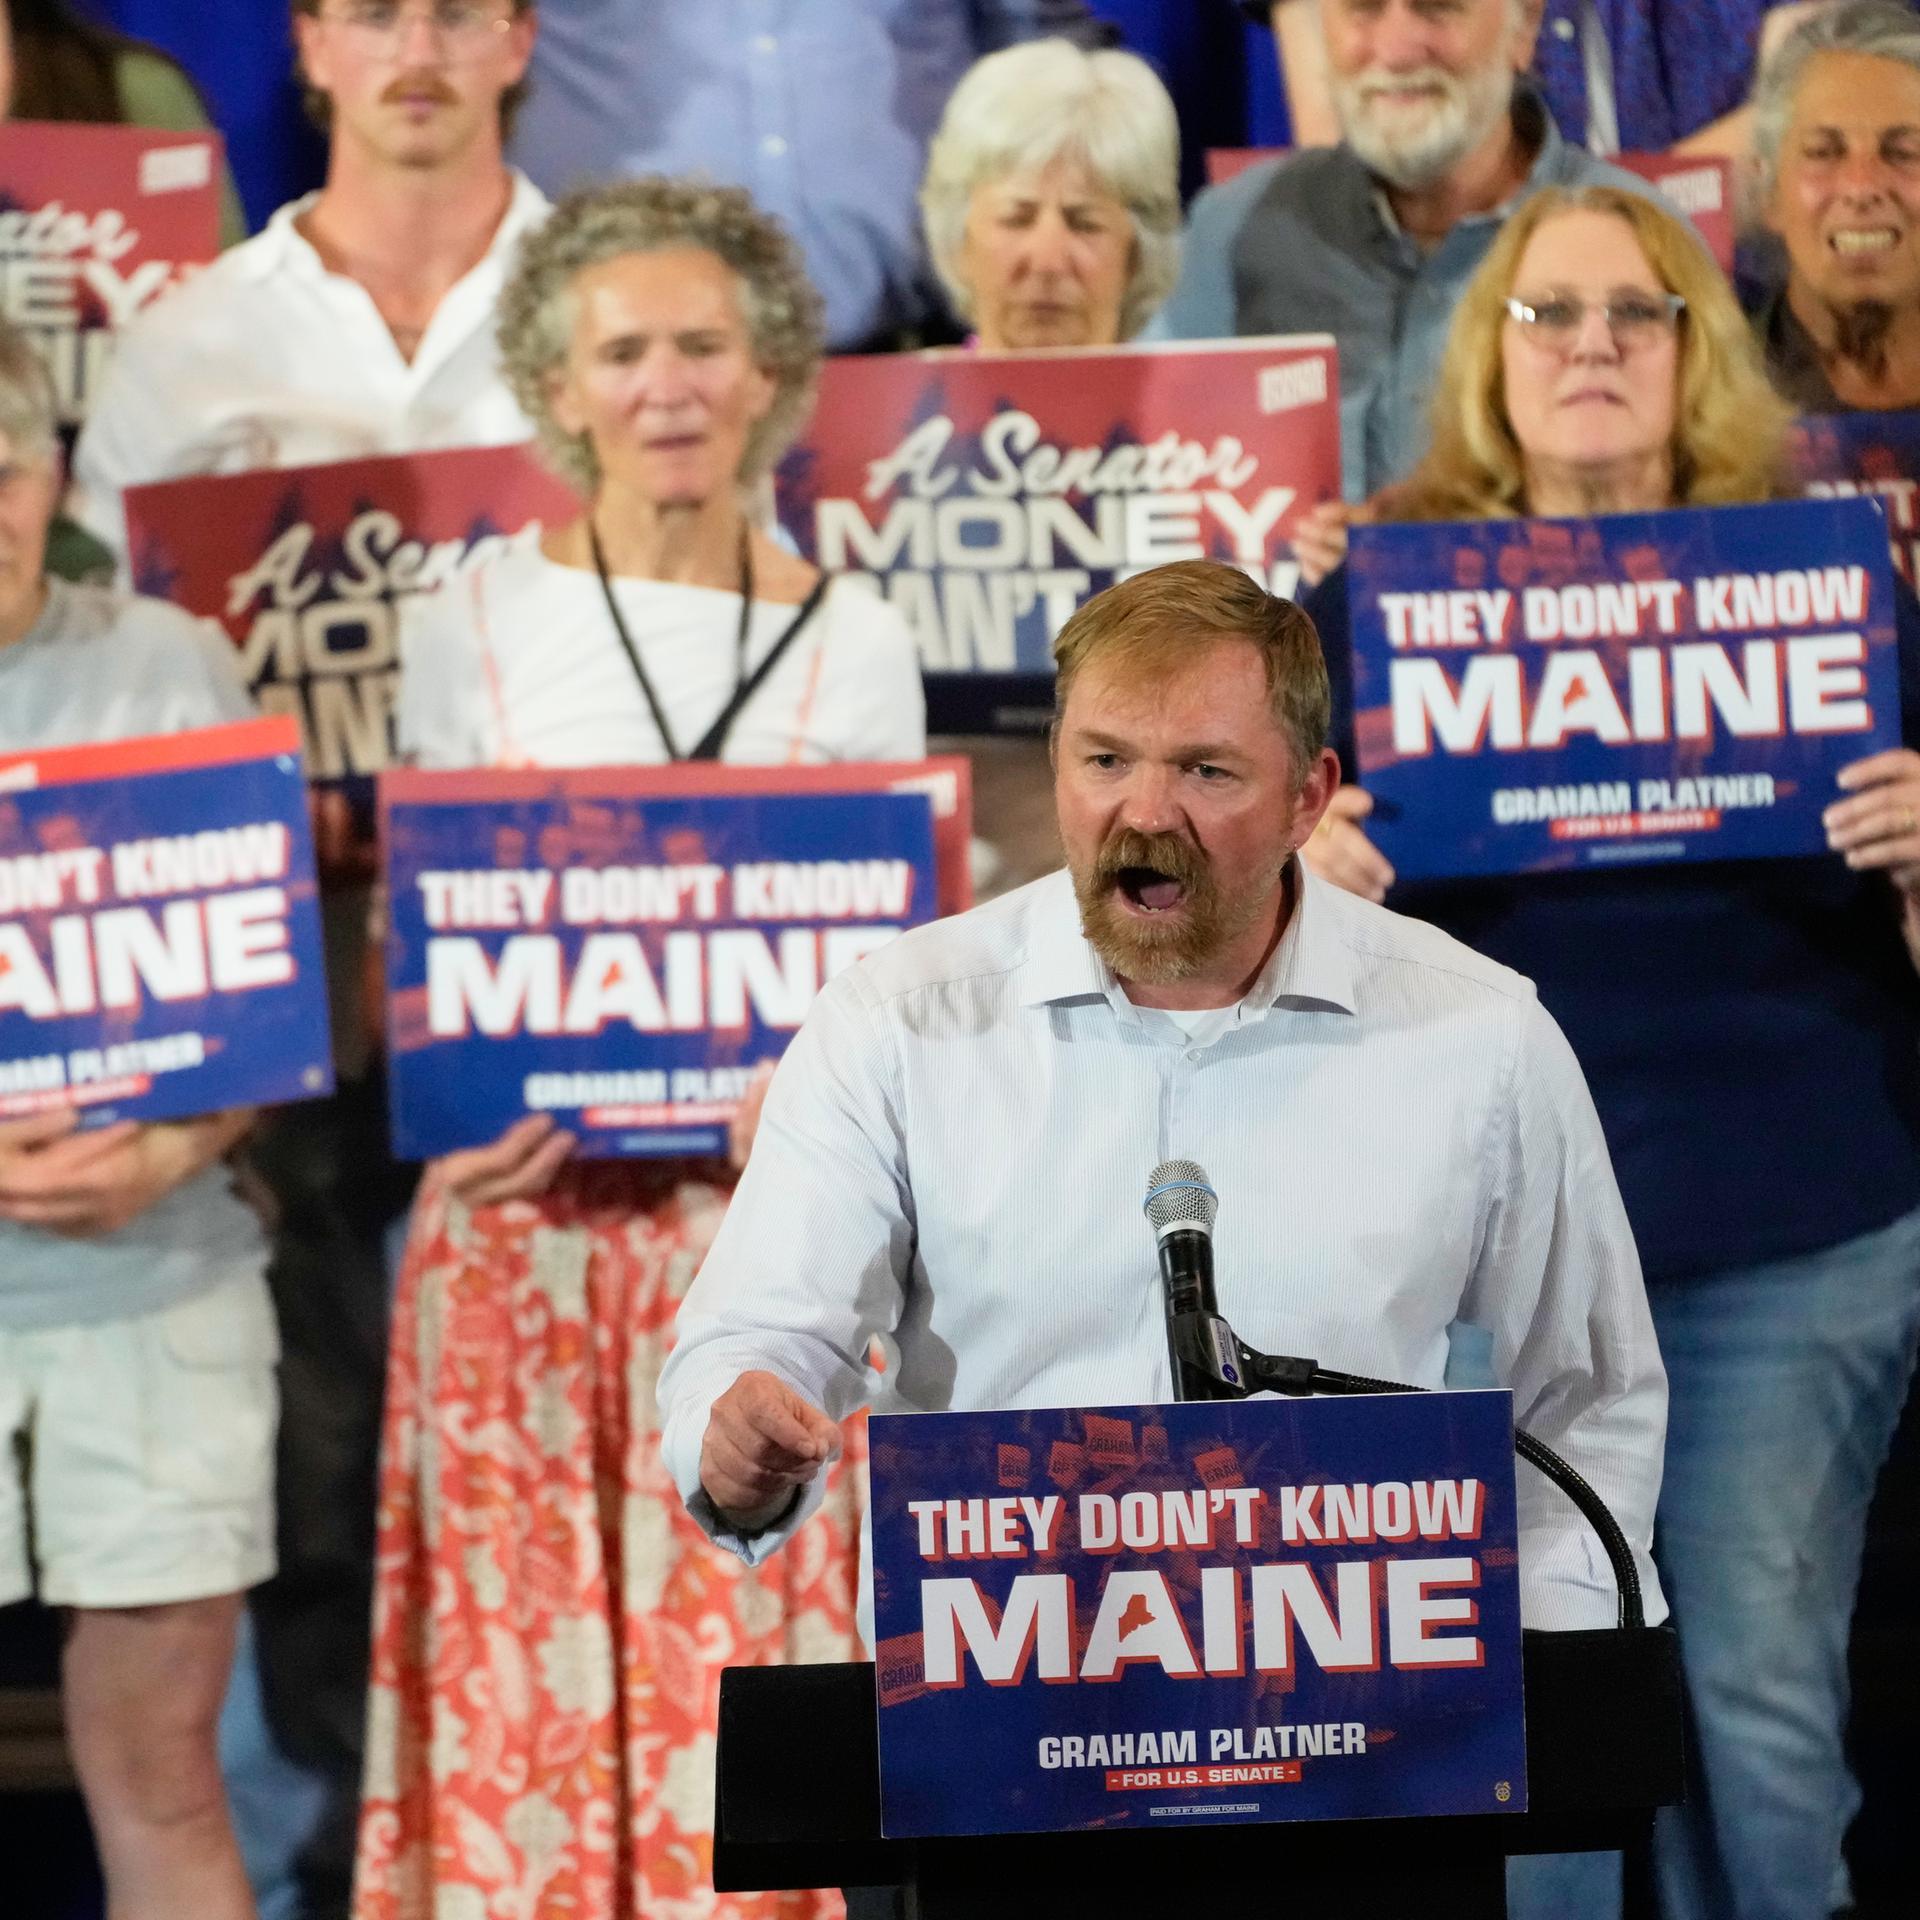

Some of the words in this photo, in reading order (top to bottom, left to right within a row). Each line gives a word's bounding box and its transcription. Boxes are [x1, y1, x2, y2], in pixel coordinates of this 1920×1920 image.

[867, 416, 960, 498] A
[970, 410, 1258, 498] Senator
[815, 487, 1297, 568] MONEY
[225, 522, 322, 615] A
[1378, 590, 1511, 648] THEY
[1523, 579, 1683, 642] DON'T
[1694, 564, 1870, 632] KNOW
[880, 568, 1089, 673] AN'T
[1389, 632, 1875, 756] MAINE
[1492, 781, 1632, 824] GRAHAM
[1637, 771, 1776, 812] PLATNER
[111, 820, 291, 898] KNOW
[416, 868, 554, 926] THEY
[561, 864, 725, 922] DON'T
[732, 858, 912, 918] KNOW
[523, 1069, 668, 1108] GRAHAM
[671, 1066, 758, 1104] PLAT
[907, 1496, 1064, 1562] THEY
[1080, 1488, 1267, 1555] DON'T
[1281, 1478, 1484, 1546] KNOW
[920, 1557, 1485, 1687] MAINE
[1038, 1730, 1197, 1770] GRAHAM
[1210, 1722, 1367, 1762] PLATNER
[1122, 1771, 1161, 1788] FOR
[1167, 1769, 1203, 1786] U.S.
[1208, 1766, 1285, 1783] SENATE
[1192, 1806, 1220, 1814] GRAHAM
